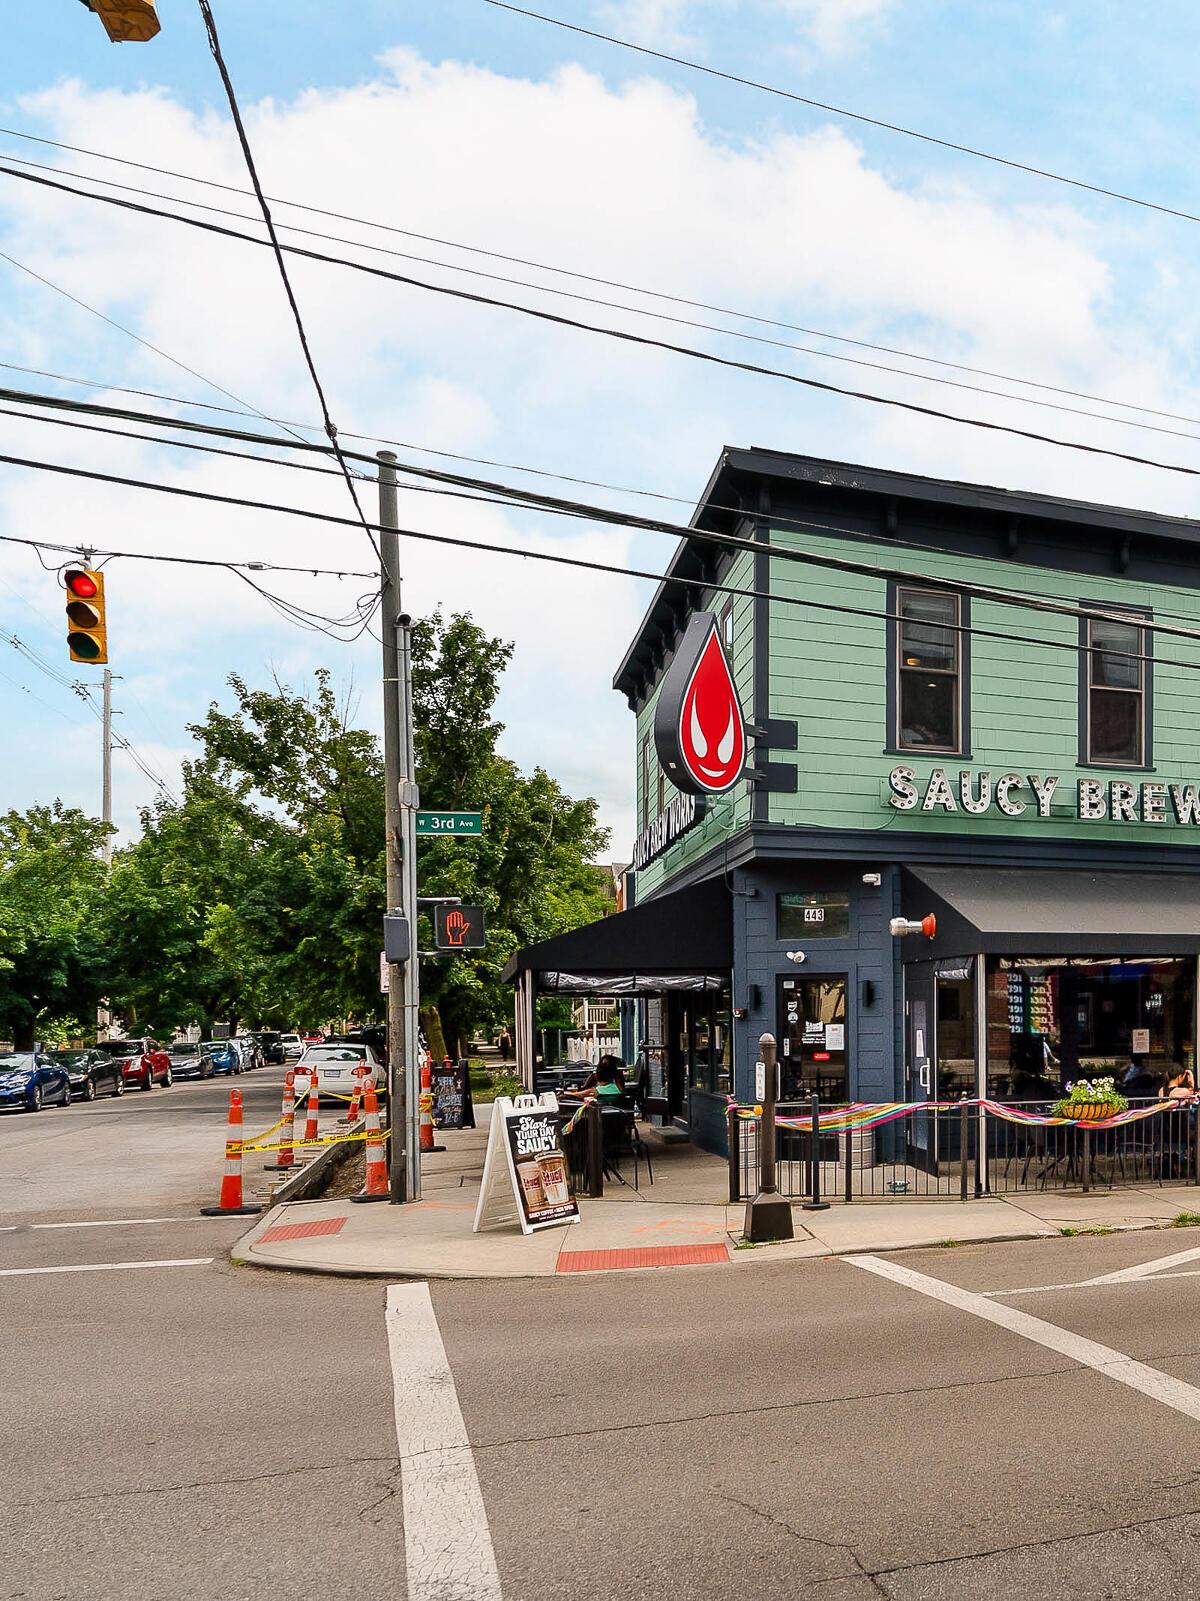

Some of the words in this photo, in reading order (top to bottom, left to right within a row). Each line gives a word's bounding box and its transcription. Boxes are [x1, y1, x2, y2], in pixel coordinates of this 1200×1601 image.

[888, 766, 1058, 817] SAUCY
[431, 816, 455, 829] 3rd
[669, 792, 695, 840] WORKS
[805, 910, 823, 920] 443
[519, 1116, 548, 1131] Start
[515, 1129, 539, 1140] YOUR
[540, 1126, 555, 1137] DAY
[517, 1135, 557, 1155] SAUCY
